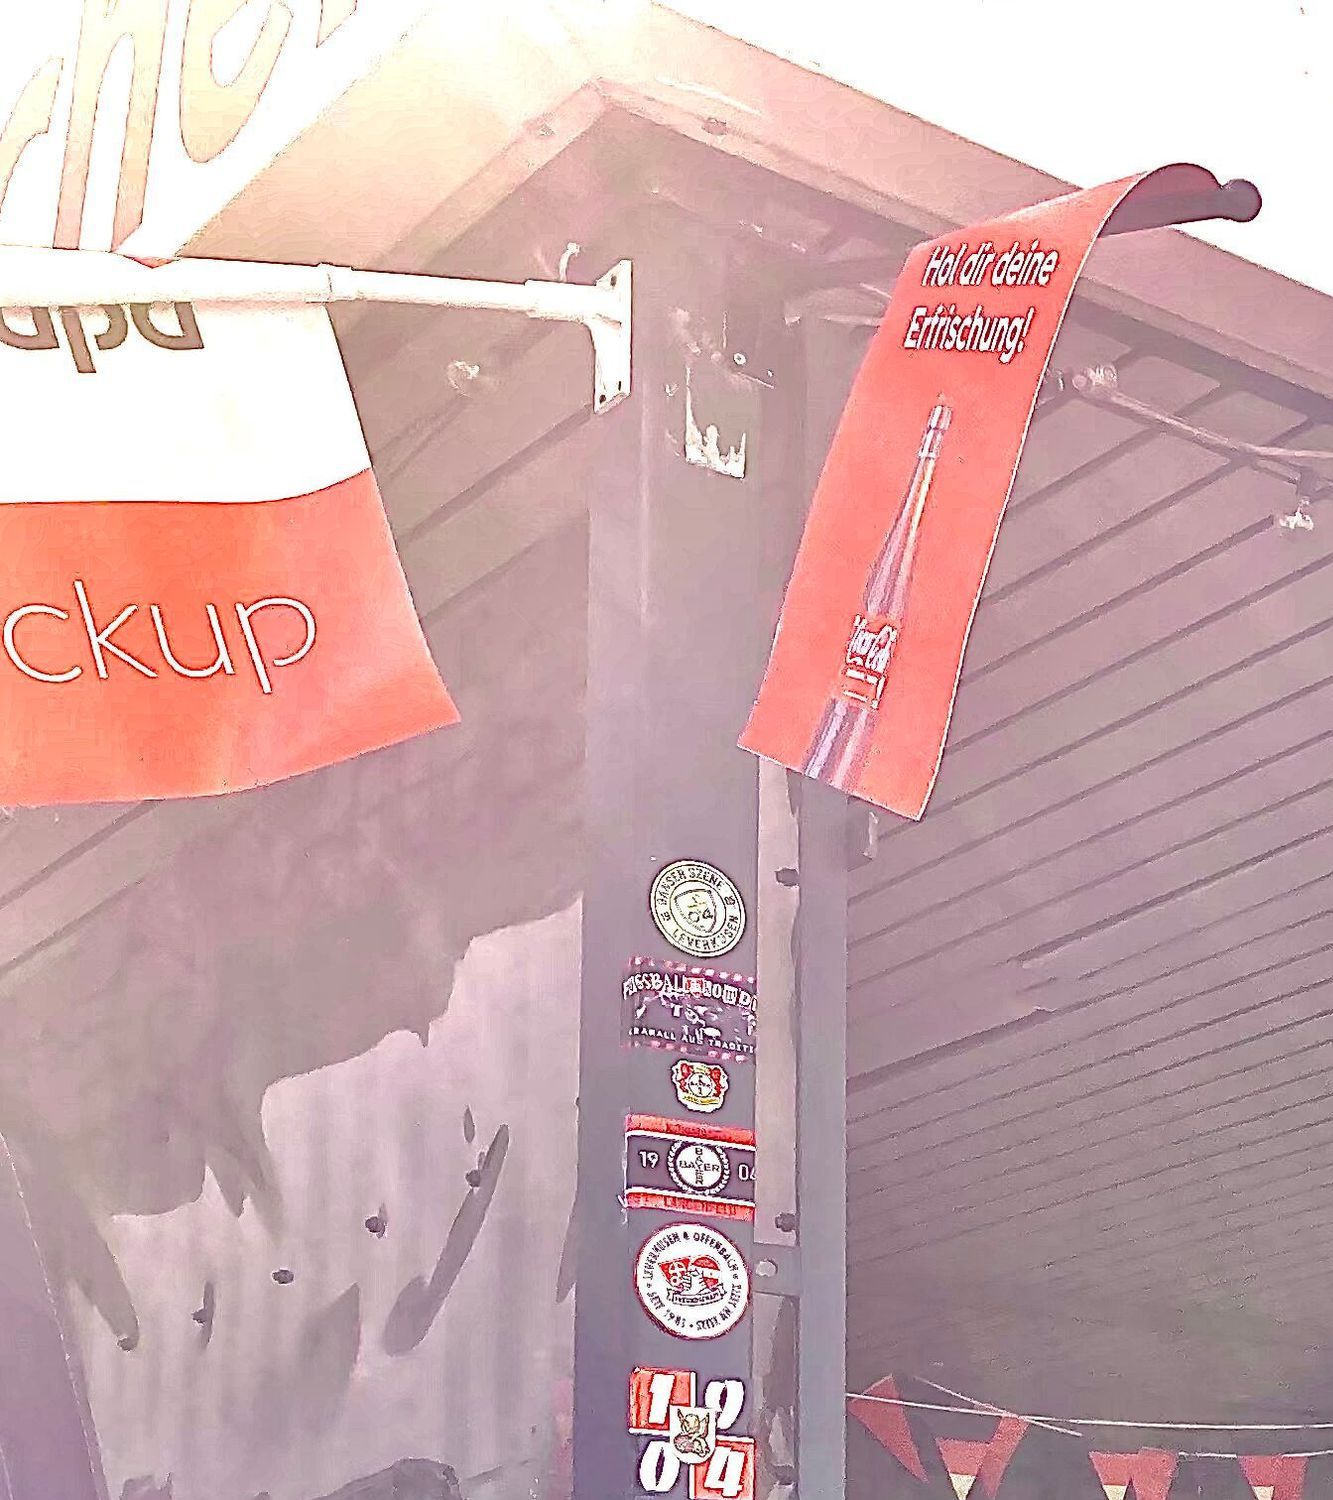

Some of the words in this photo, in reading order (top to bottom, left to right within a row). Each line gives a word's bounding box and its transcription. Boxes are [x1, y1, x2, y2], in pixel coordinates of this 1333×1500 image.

[922, 243, 967, 287] Hol
[959, 241, 994, 286] dir
[992, 239, 1059, 287] deine
[904, 304, 1036, 364] Erfrischung!
[638, 1150, 660, 1169] 19
